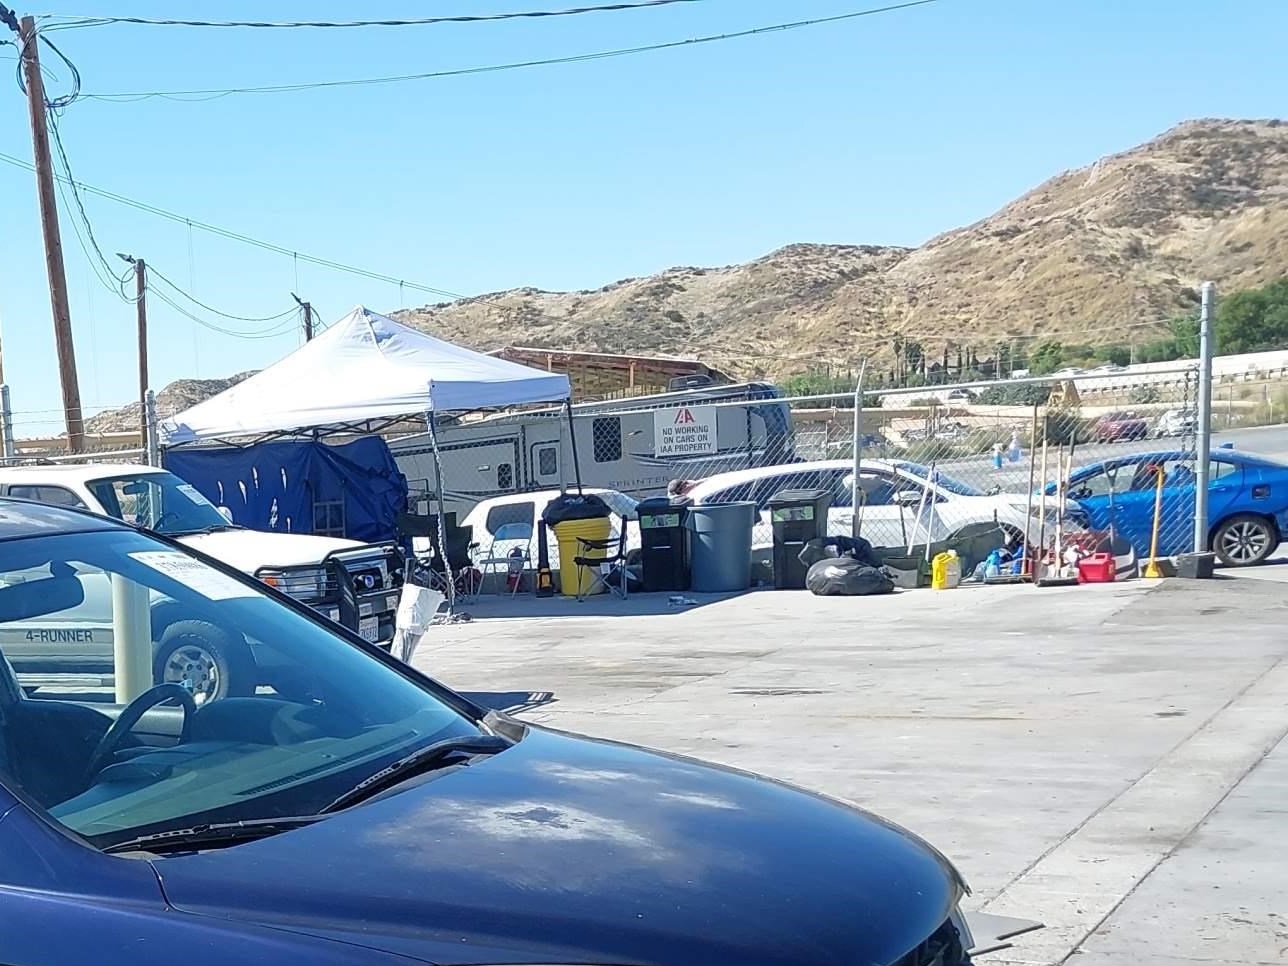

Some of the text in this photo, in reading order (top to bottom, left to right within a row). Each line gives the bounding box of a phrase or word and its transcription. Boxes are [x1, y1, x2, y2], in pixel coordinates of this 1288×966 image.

[675, 425, 709, 434] WORKING
[676, 435, 695, 443] CARS
[660, 443, 712, 453] IAA PROPERTY
[608, 476, 668, 487] SPRINTER
[25, 630, 93, 642] 4-RUNNER
